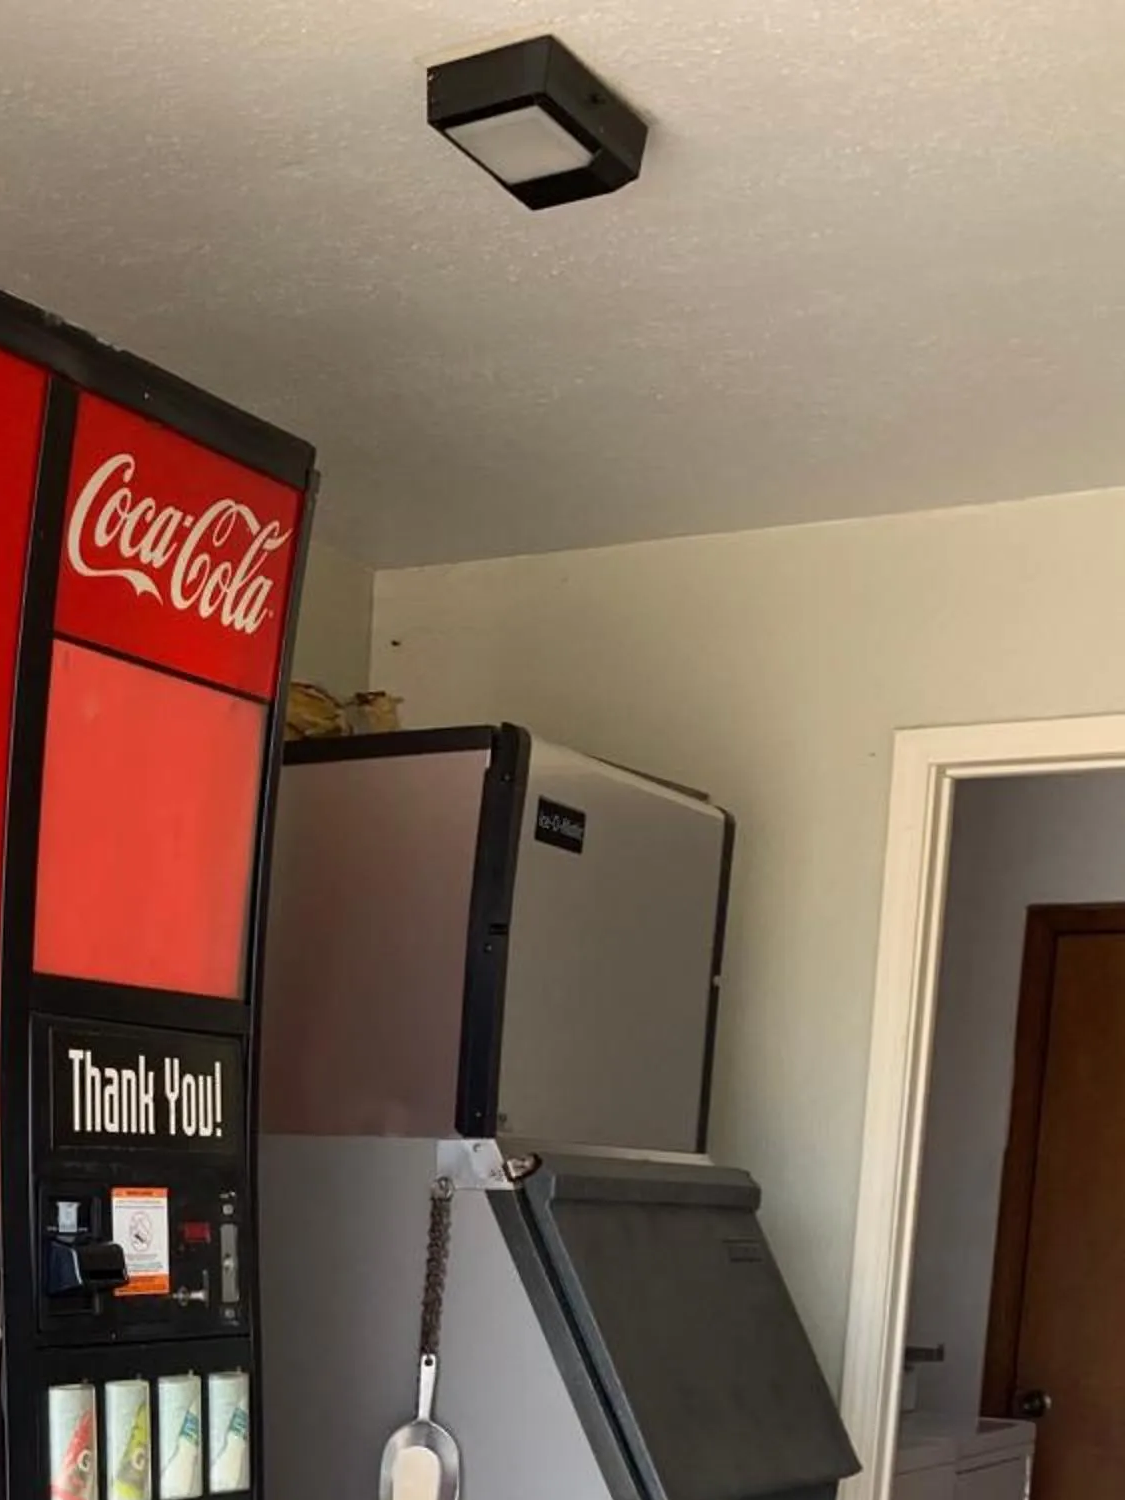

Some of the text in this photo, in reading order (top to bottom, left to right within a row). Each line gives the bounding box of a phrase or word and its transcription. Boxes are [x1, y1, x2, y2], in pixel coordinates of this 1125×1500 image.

[68, 453, 293, 634] Coca-Cola
[68, 1049, 223, 1137] Thank You!
